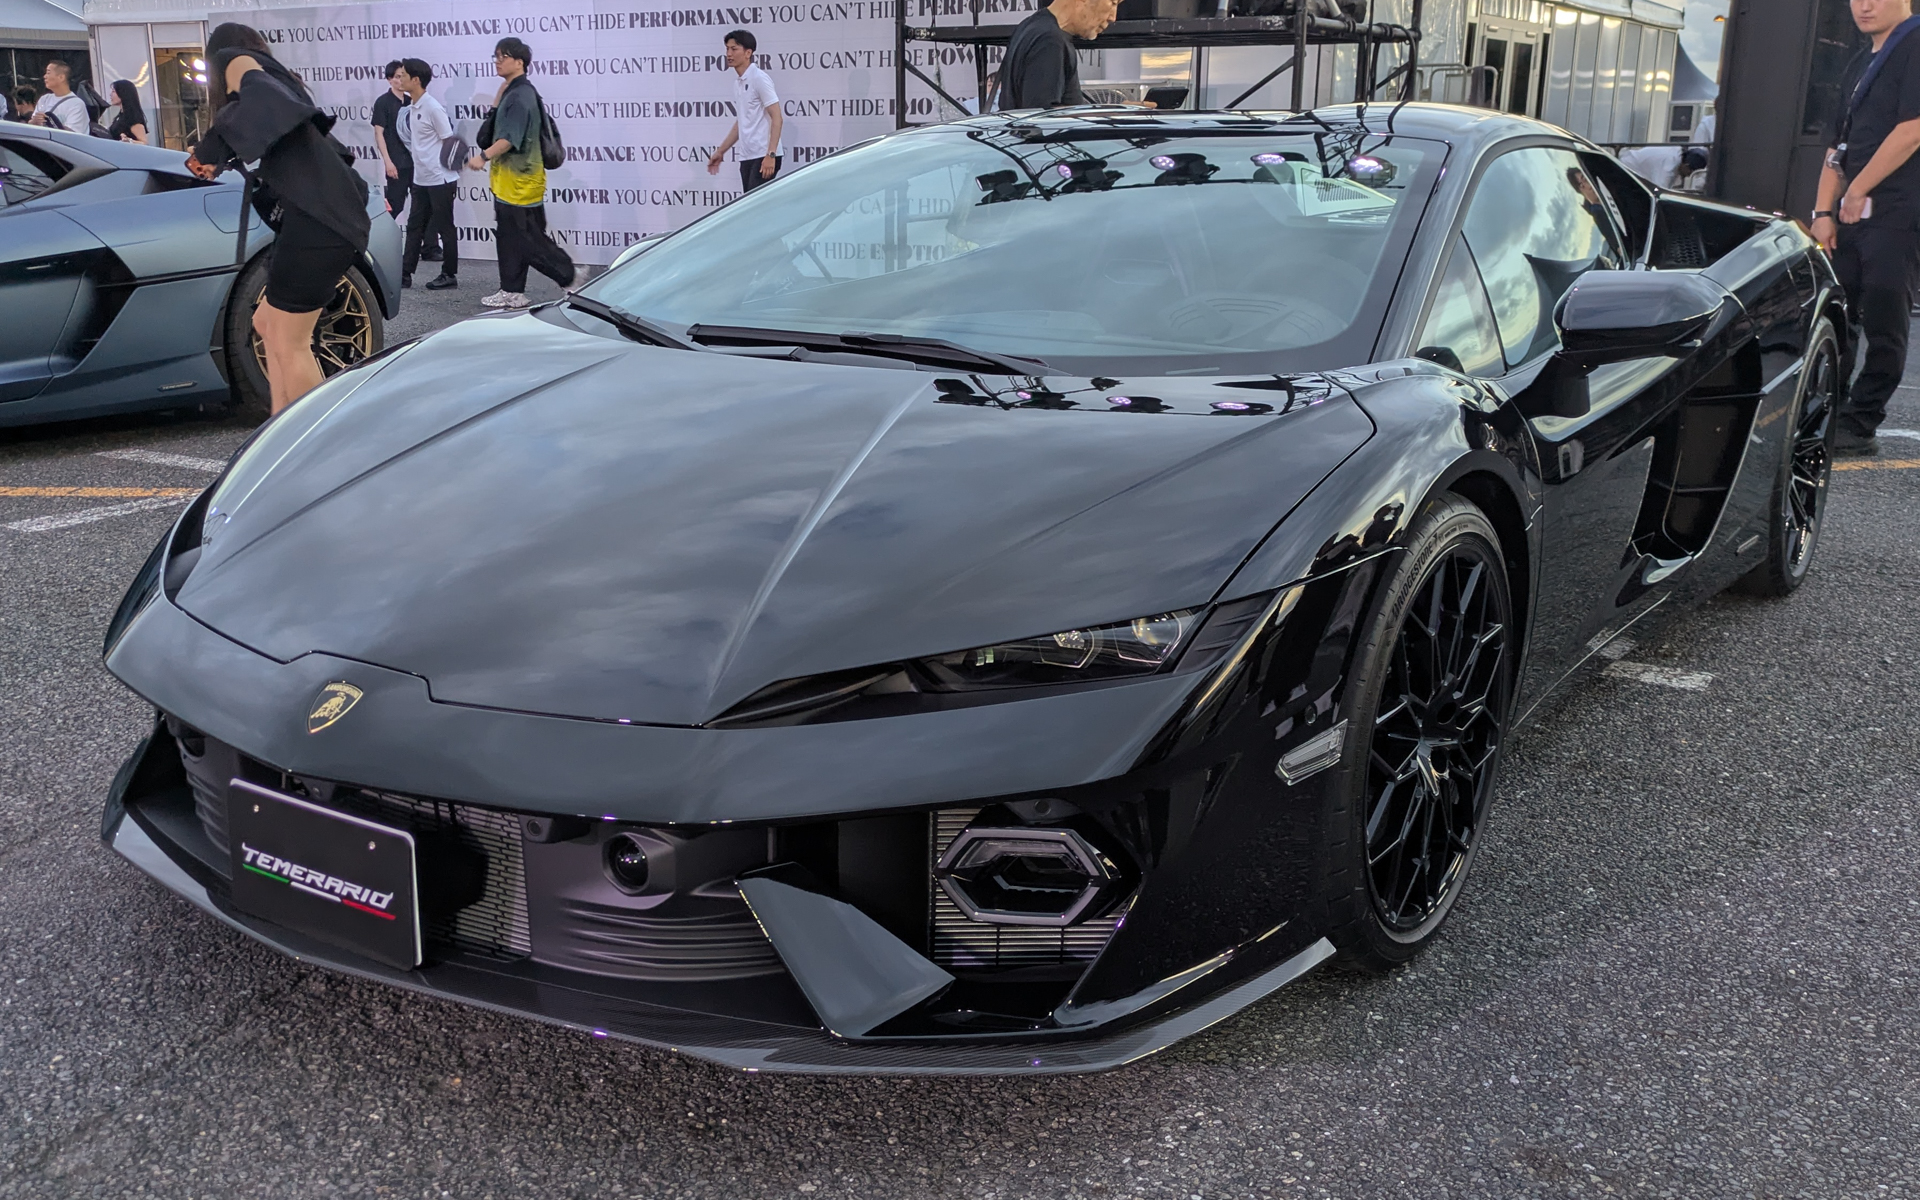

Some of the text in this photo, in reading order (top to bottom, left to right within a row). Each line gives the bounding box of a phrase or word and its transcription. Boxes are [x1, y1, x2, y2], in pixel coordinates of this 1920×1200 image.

[288, 27, 315, 43] YOU
[317, 25, 356, 42] CAN'T
[358, 23, 389, 40] HIDE
[391, 19, 501, 39] PERFORMANCE
[505, 17, 536, 34] YOU
[539, 14, 585, 33] CAN'T
[588, 12, 626, 31] HIDE
[629, 7, 763, 29] PERFORMANCE
[769, 5, 806, 24] YOU
[810, 2, 866, 22] CAN'T
[870, 0, 915, 19] HIE
[918, 0, 1038, 17] PERFORMA
[312, 66, 343, 82] HIDE
[344, 65, 386, 81] POWE
[432, 62, 472, 79] CAN'T
[474, 62, 499, 78] HID
[528, 59, 569, 76] OWER
[574, 57, 607, 76] YOU
[610, 56, 658, 75] CAN'T
[661, 55, 701, 74] HIDE
[704, 53, 772, 72] POER
[778, 51, 815, 71] YOU
[819, 50, 875, 70] CAN'T
[927, 46, 1004, 66] POWR
[544, 103, 561, 119] OU
[564, 101, 610, 119] CAN'T
[613, 101, 651, 118] HIDE
[784, 99, 838, 117] CAN'T
[841, 98, 885, 116] HIDE
[565, 146, 636, 162] RMANCE
[640, 146, 674, 162] YOU
[551, 188, 610, 204] POWER
[615, 189, 647, 205] YOU
[651, 189, 700, 207] CAN'T
[550, 229, 582, 246] AN'T
[585, 230, 620, 247] HIDE
[241, 842, 394, 910] TEMERARIO
